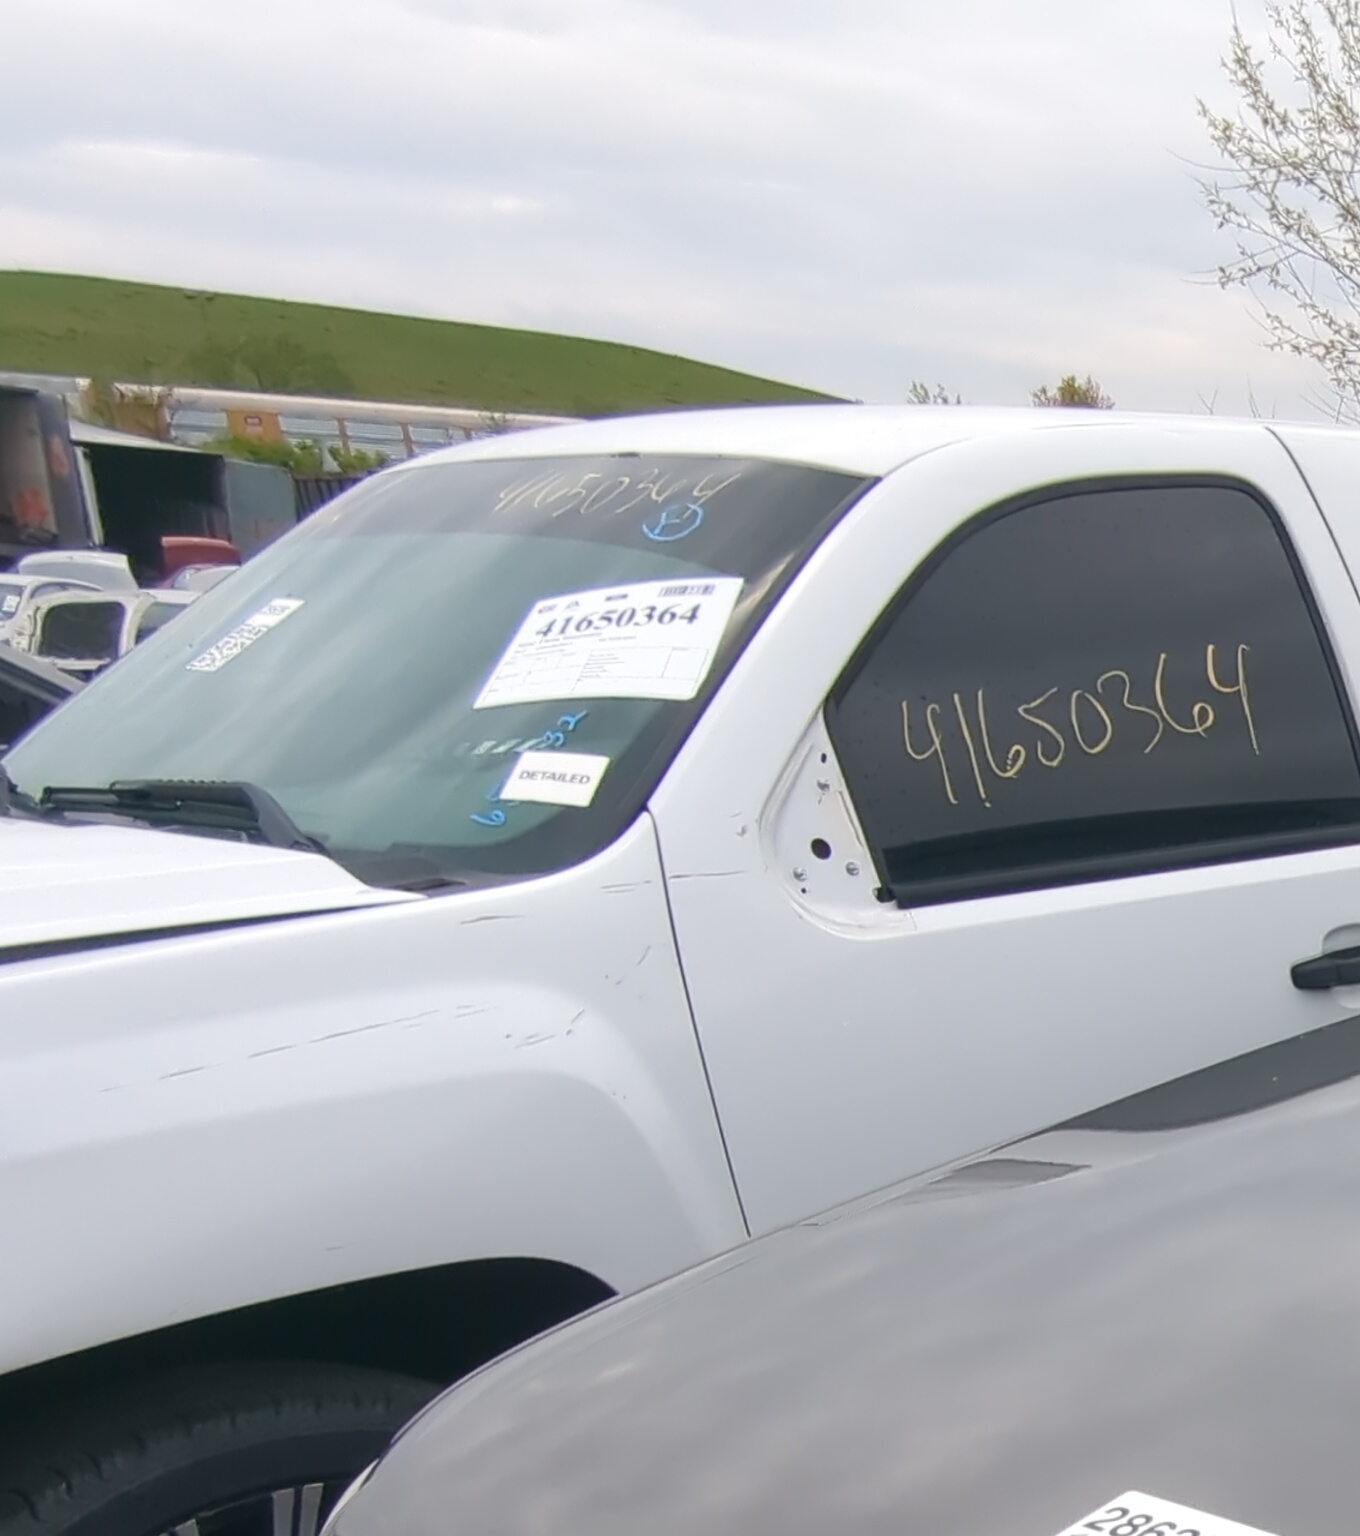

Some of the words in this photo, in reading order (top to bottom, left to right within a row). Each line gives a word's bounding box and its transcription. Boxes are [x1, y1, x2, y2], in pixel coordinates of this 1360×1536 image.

[535, 603, 702, 638] 41650364
[901, 643, 1261, 808] 41650364
[518, 770, 591, 785] DETAILED
